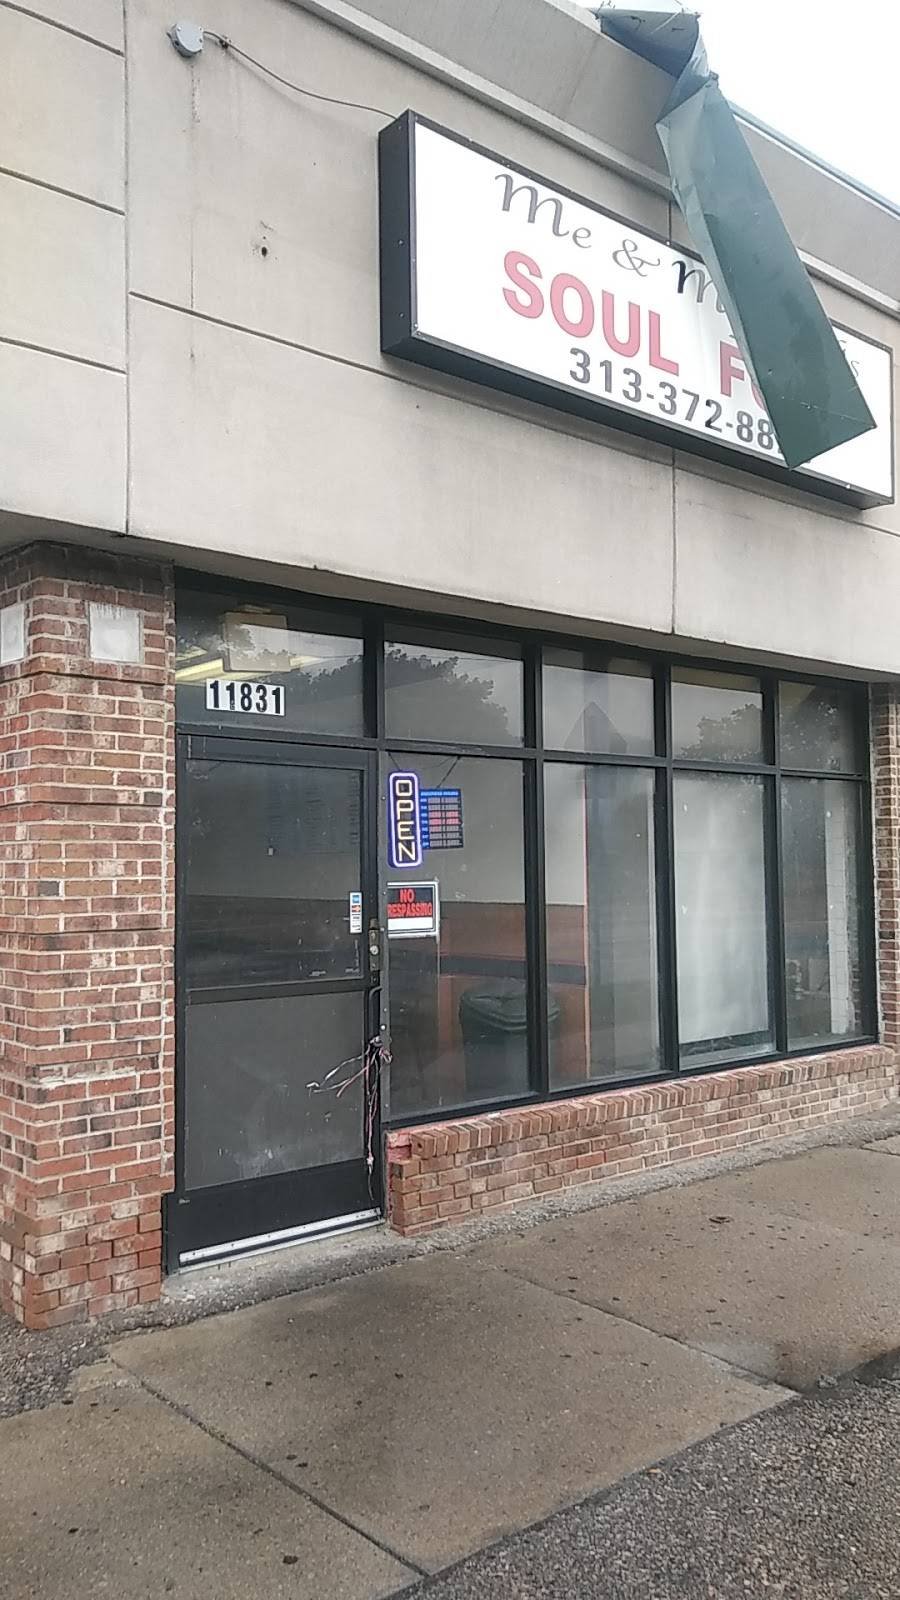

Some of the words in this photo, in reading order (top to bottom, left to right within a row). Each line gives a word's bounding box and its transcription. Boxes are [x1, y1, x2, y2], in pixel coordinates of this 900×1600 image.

[495, 173, 592, 249] Me
[611, 239, 661, 278] &
[501, 250, 680, 377] SOUL
[569, 347, 784, 454] 313-372-88
[209, 680, 281, 715] 11831
[395, 779, 416, 862] OPEN
[387, 902, 433, 918] RESPASSING
[400, 888, 415, 903] NO
